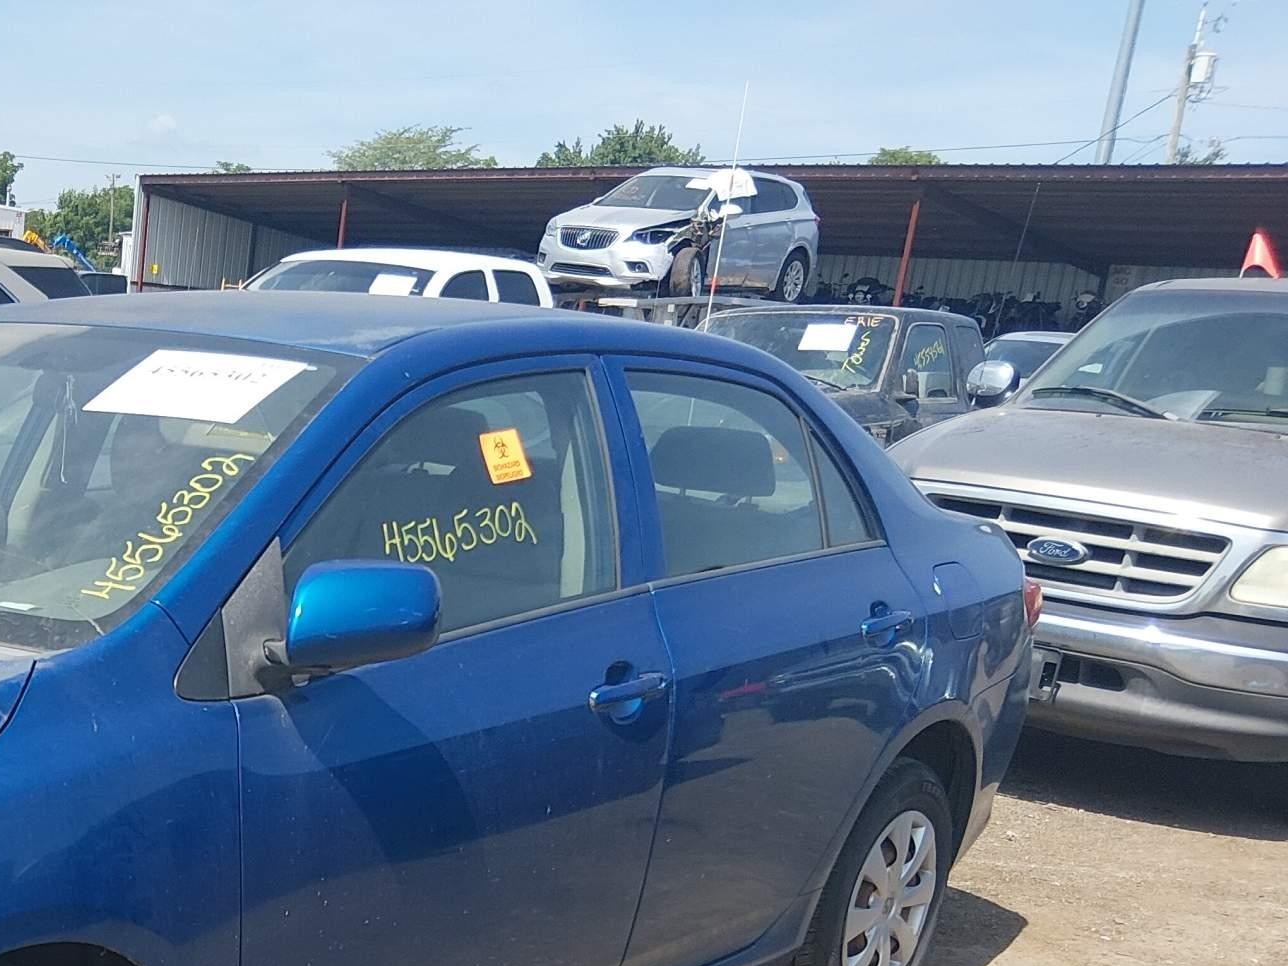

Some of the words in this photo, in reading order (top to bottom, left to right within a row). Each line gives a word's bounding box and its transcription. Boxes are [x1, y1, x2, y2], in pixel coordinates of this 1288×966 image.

[843, 316, 885, 328] ERIE
[80, 453, 256, 599] 45565302
[382, 501, 538, 563] 45565302
[1039, 541, 1072, 558] Ford
